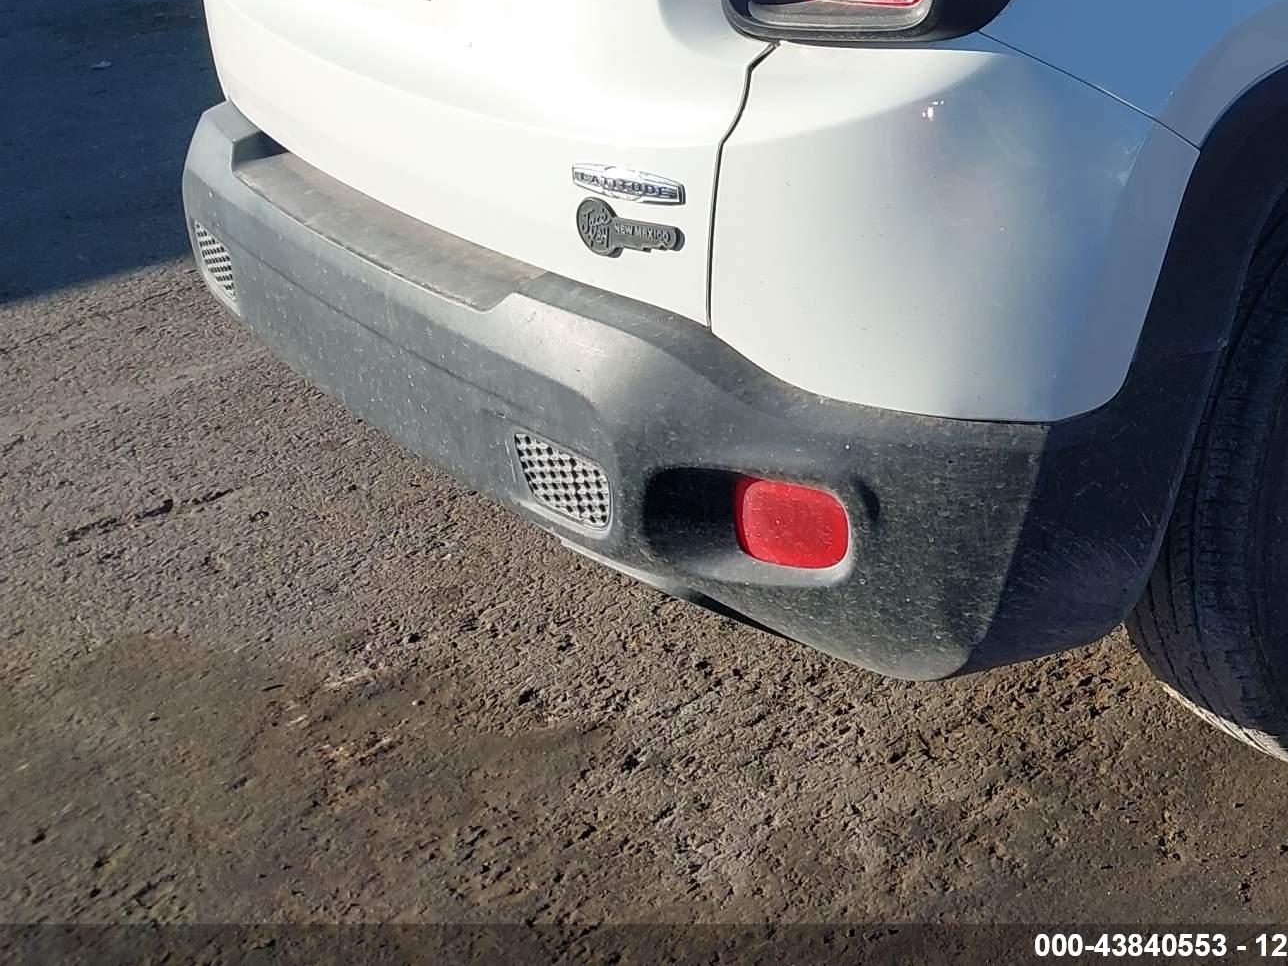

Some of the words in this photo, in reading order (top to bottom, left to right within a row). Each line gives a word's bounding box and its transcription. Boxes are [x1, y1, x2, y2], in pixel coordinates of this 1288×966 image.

[579, 171, 669, 196] LATITUDE
[614, 222, 633, 236] NEW
[634, 225, 671, 242] MEXICO
